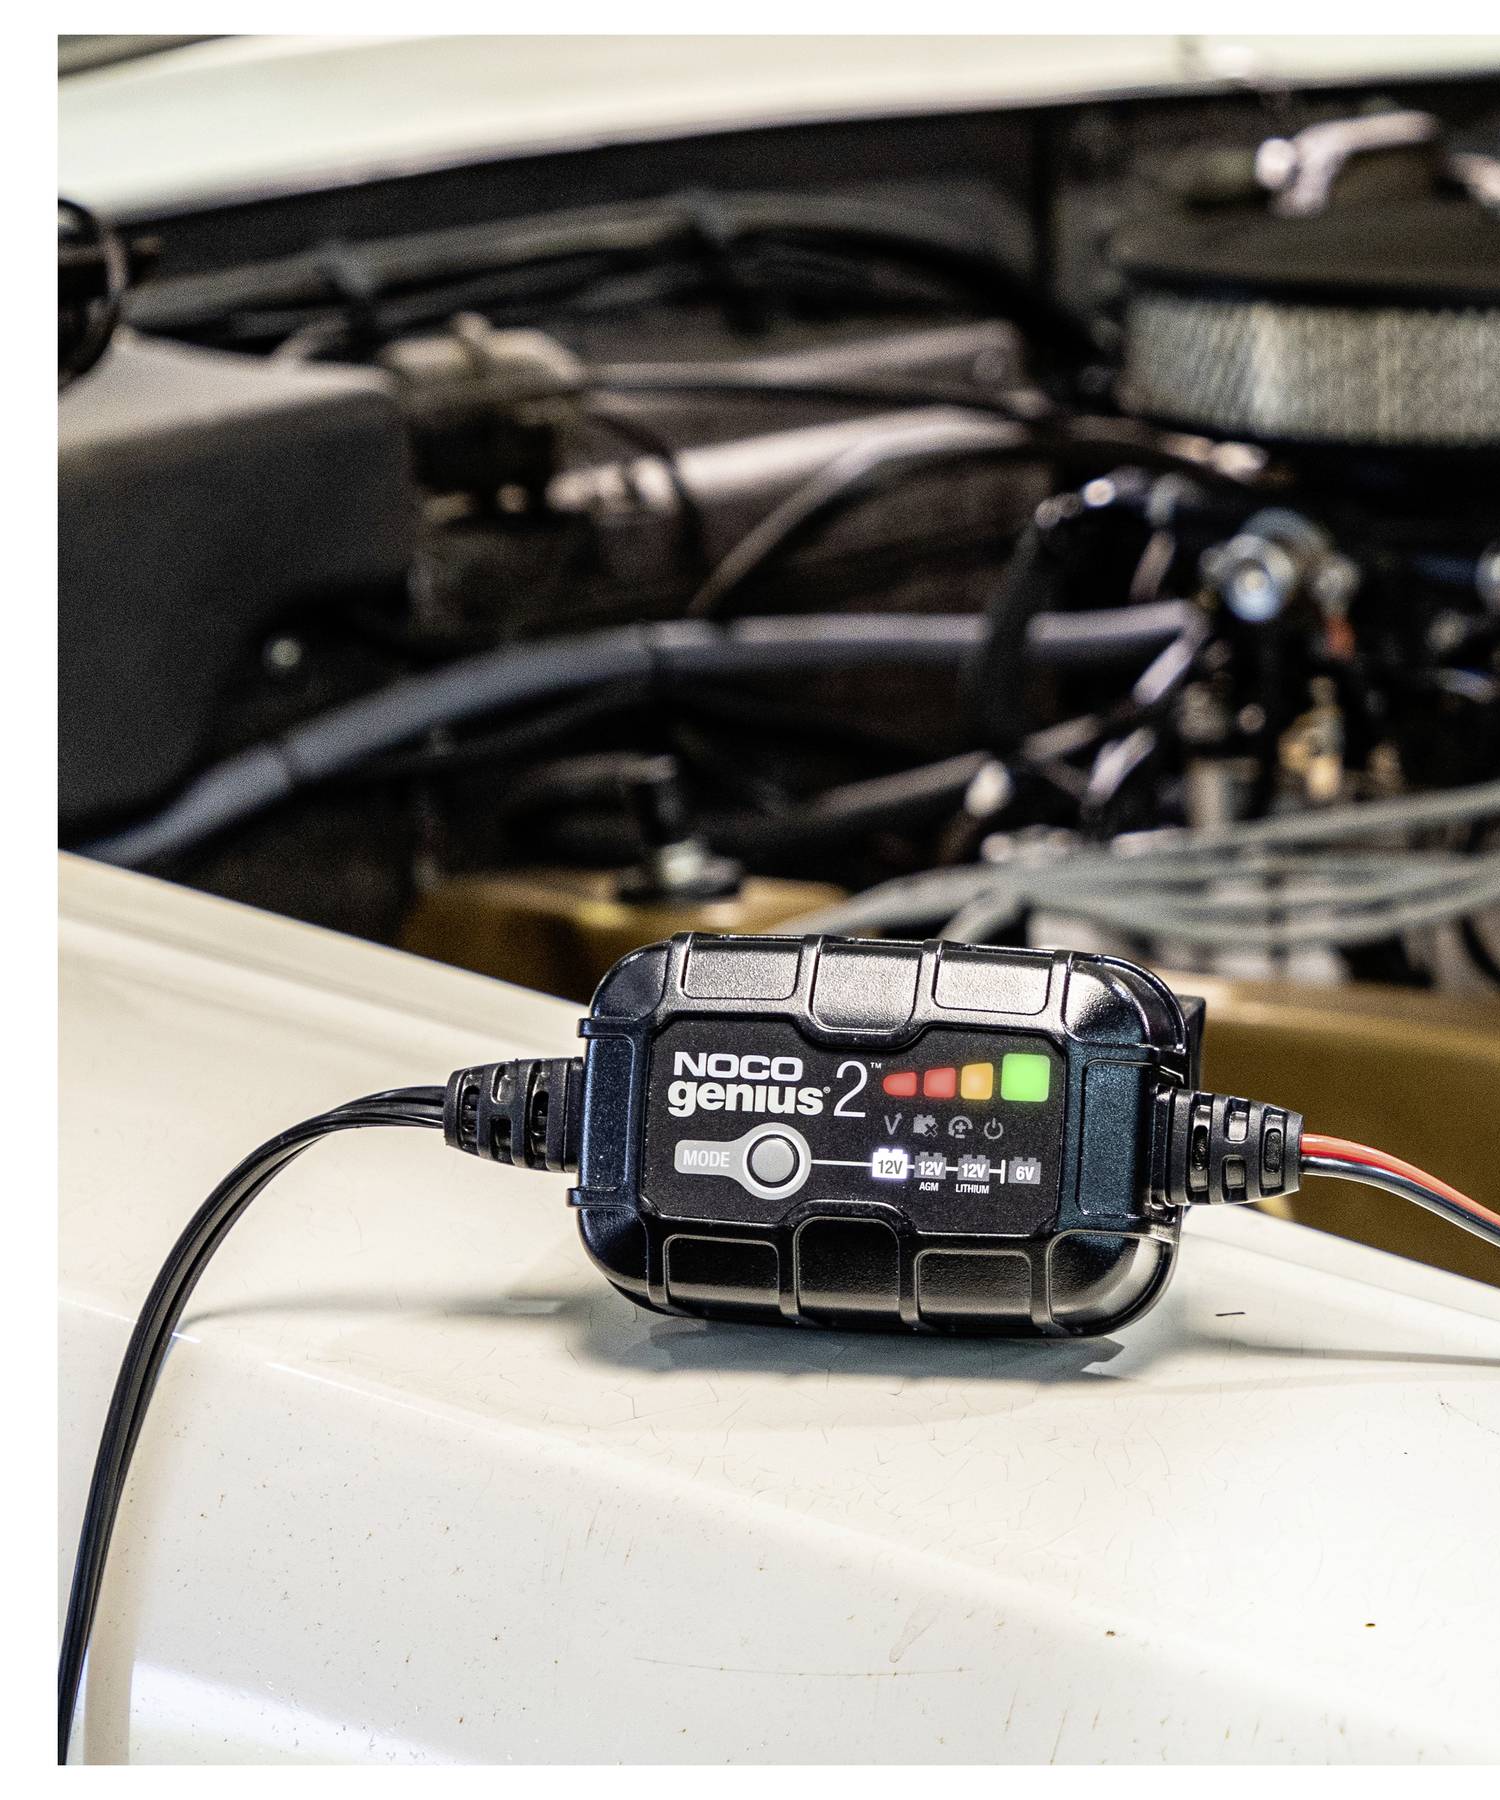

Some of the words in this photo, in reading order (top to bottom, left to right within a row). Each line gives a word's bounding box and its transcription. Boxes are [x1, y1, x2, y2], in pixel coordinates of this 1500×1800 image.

[674, 1051, 803, 1081] NOCO
[682, 1149, 730, 1168] MODE
[878, 1159, 903, 1175] 12V
[918, 1161, 944, 1177] 12V
[961, 1163, 986, 1179] 12V
[1015, 1166, 1035, 1181] 6V
[919, 1182, 939, 1192] AGM
[955, 1183, 990, 1194] LITHIUM
